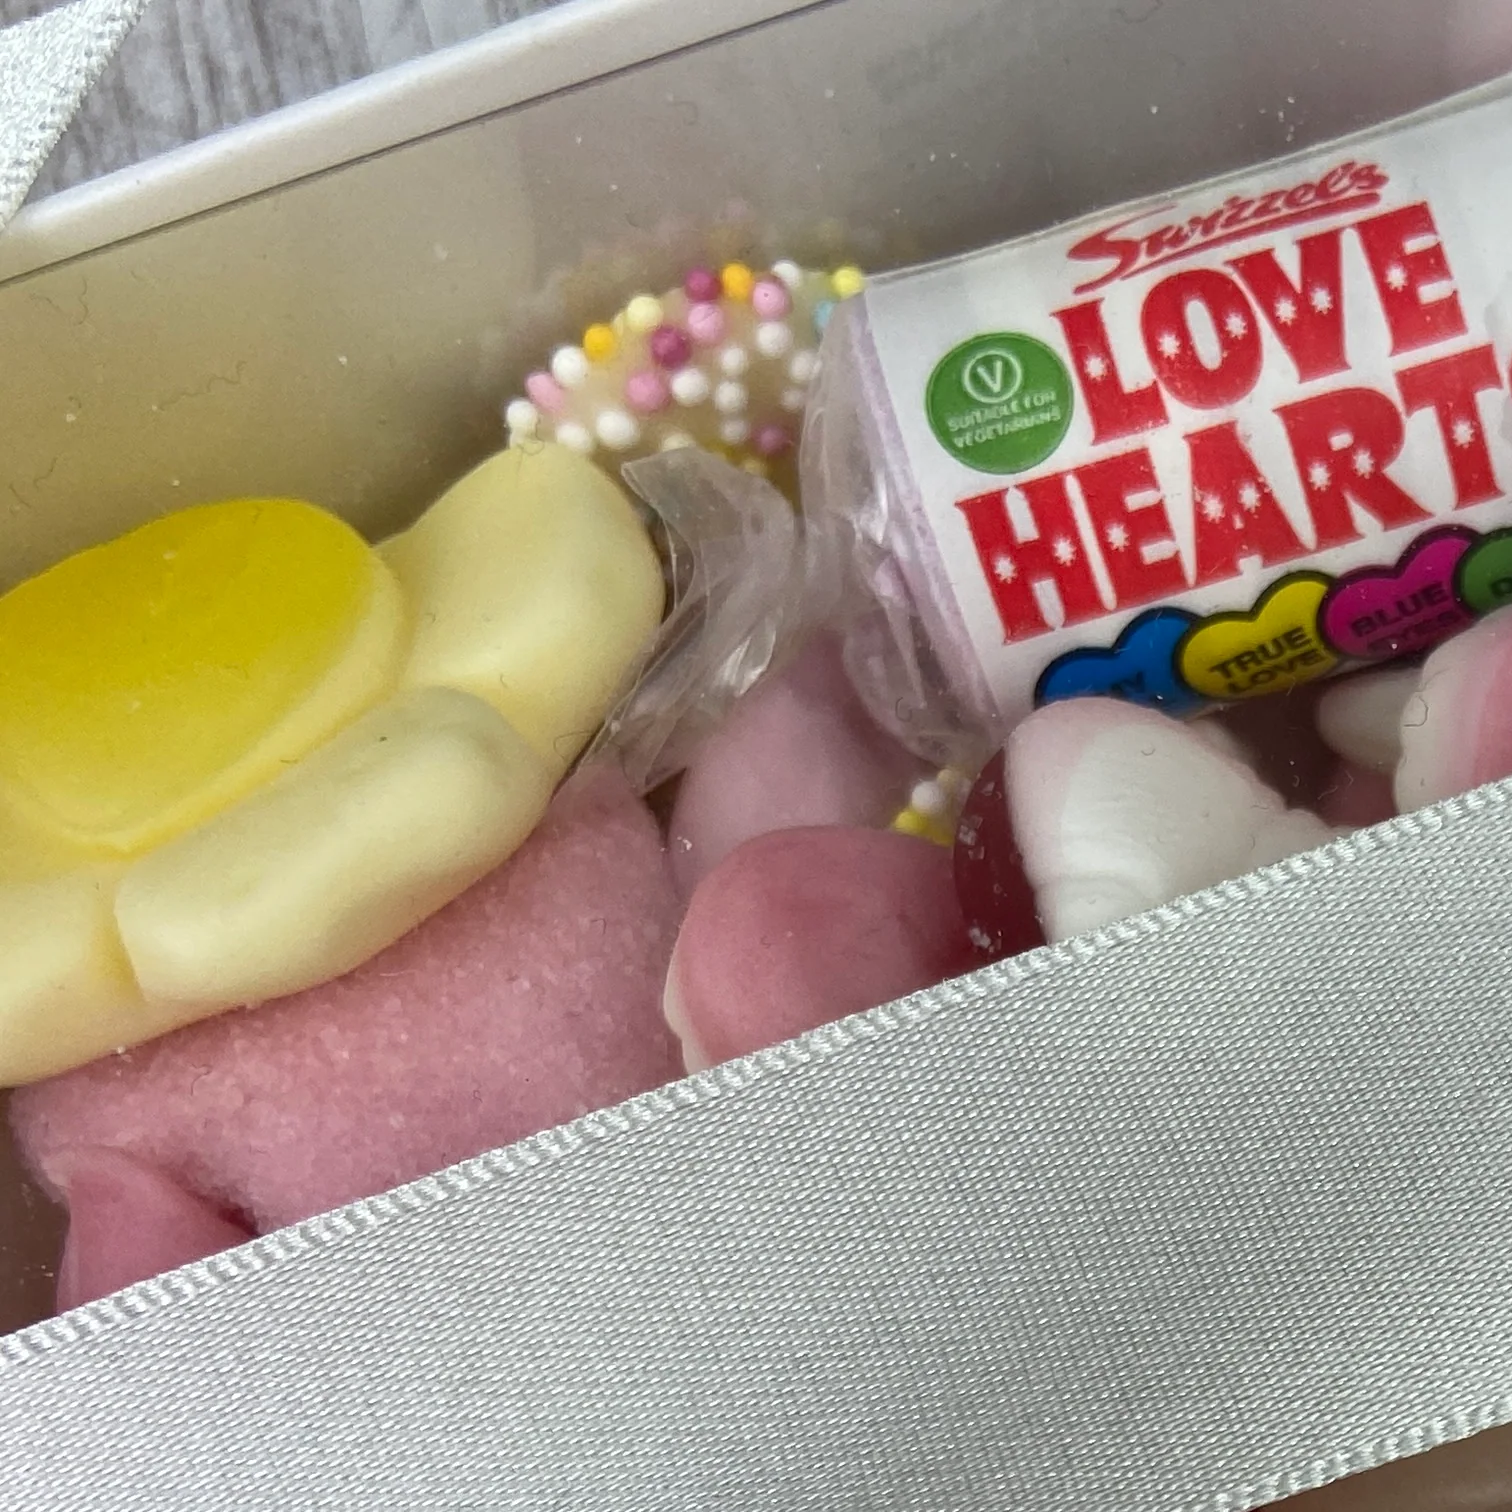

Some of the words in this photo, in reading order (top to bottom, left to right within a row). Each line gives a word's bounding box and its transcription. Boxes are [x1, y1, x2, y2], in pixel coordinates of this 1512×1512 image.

[1051, 201, 1469, 445] LOVE
[1351, 582, 1448, 638] BLUE
[1209, 626, 1313, 679] TRUE
[1227, 648, 1326, 693] LOVE
